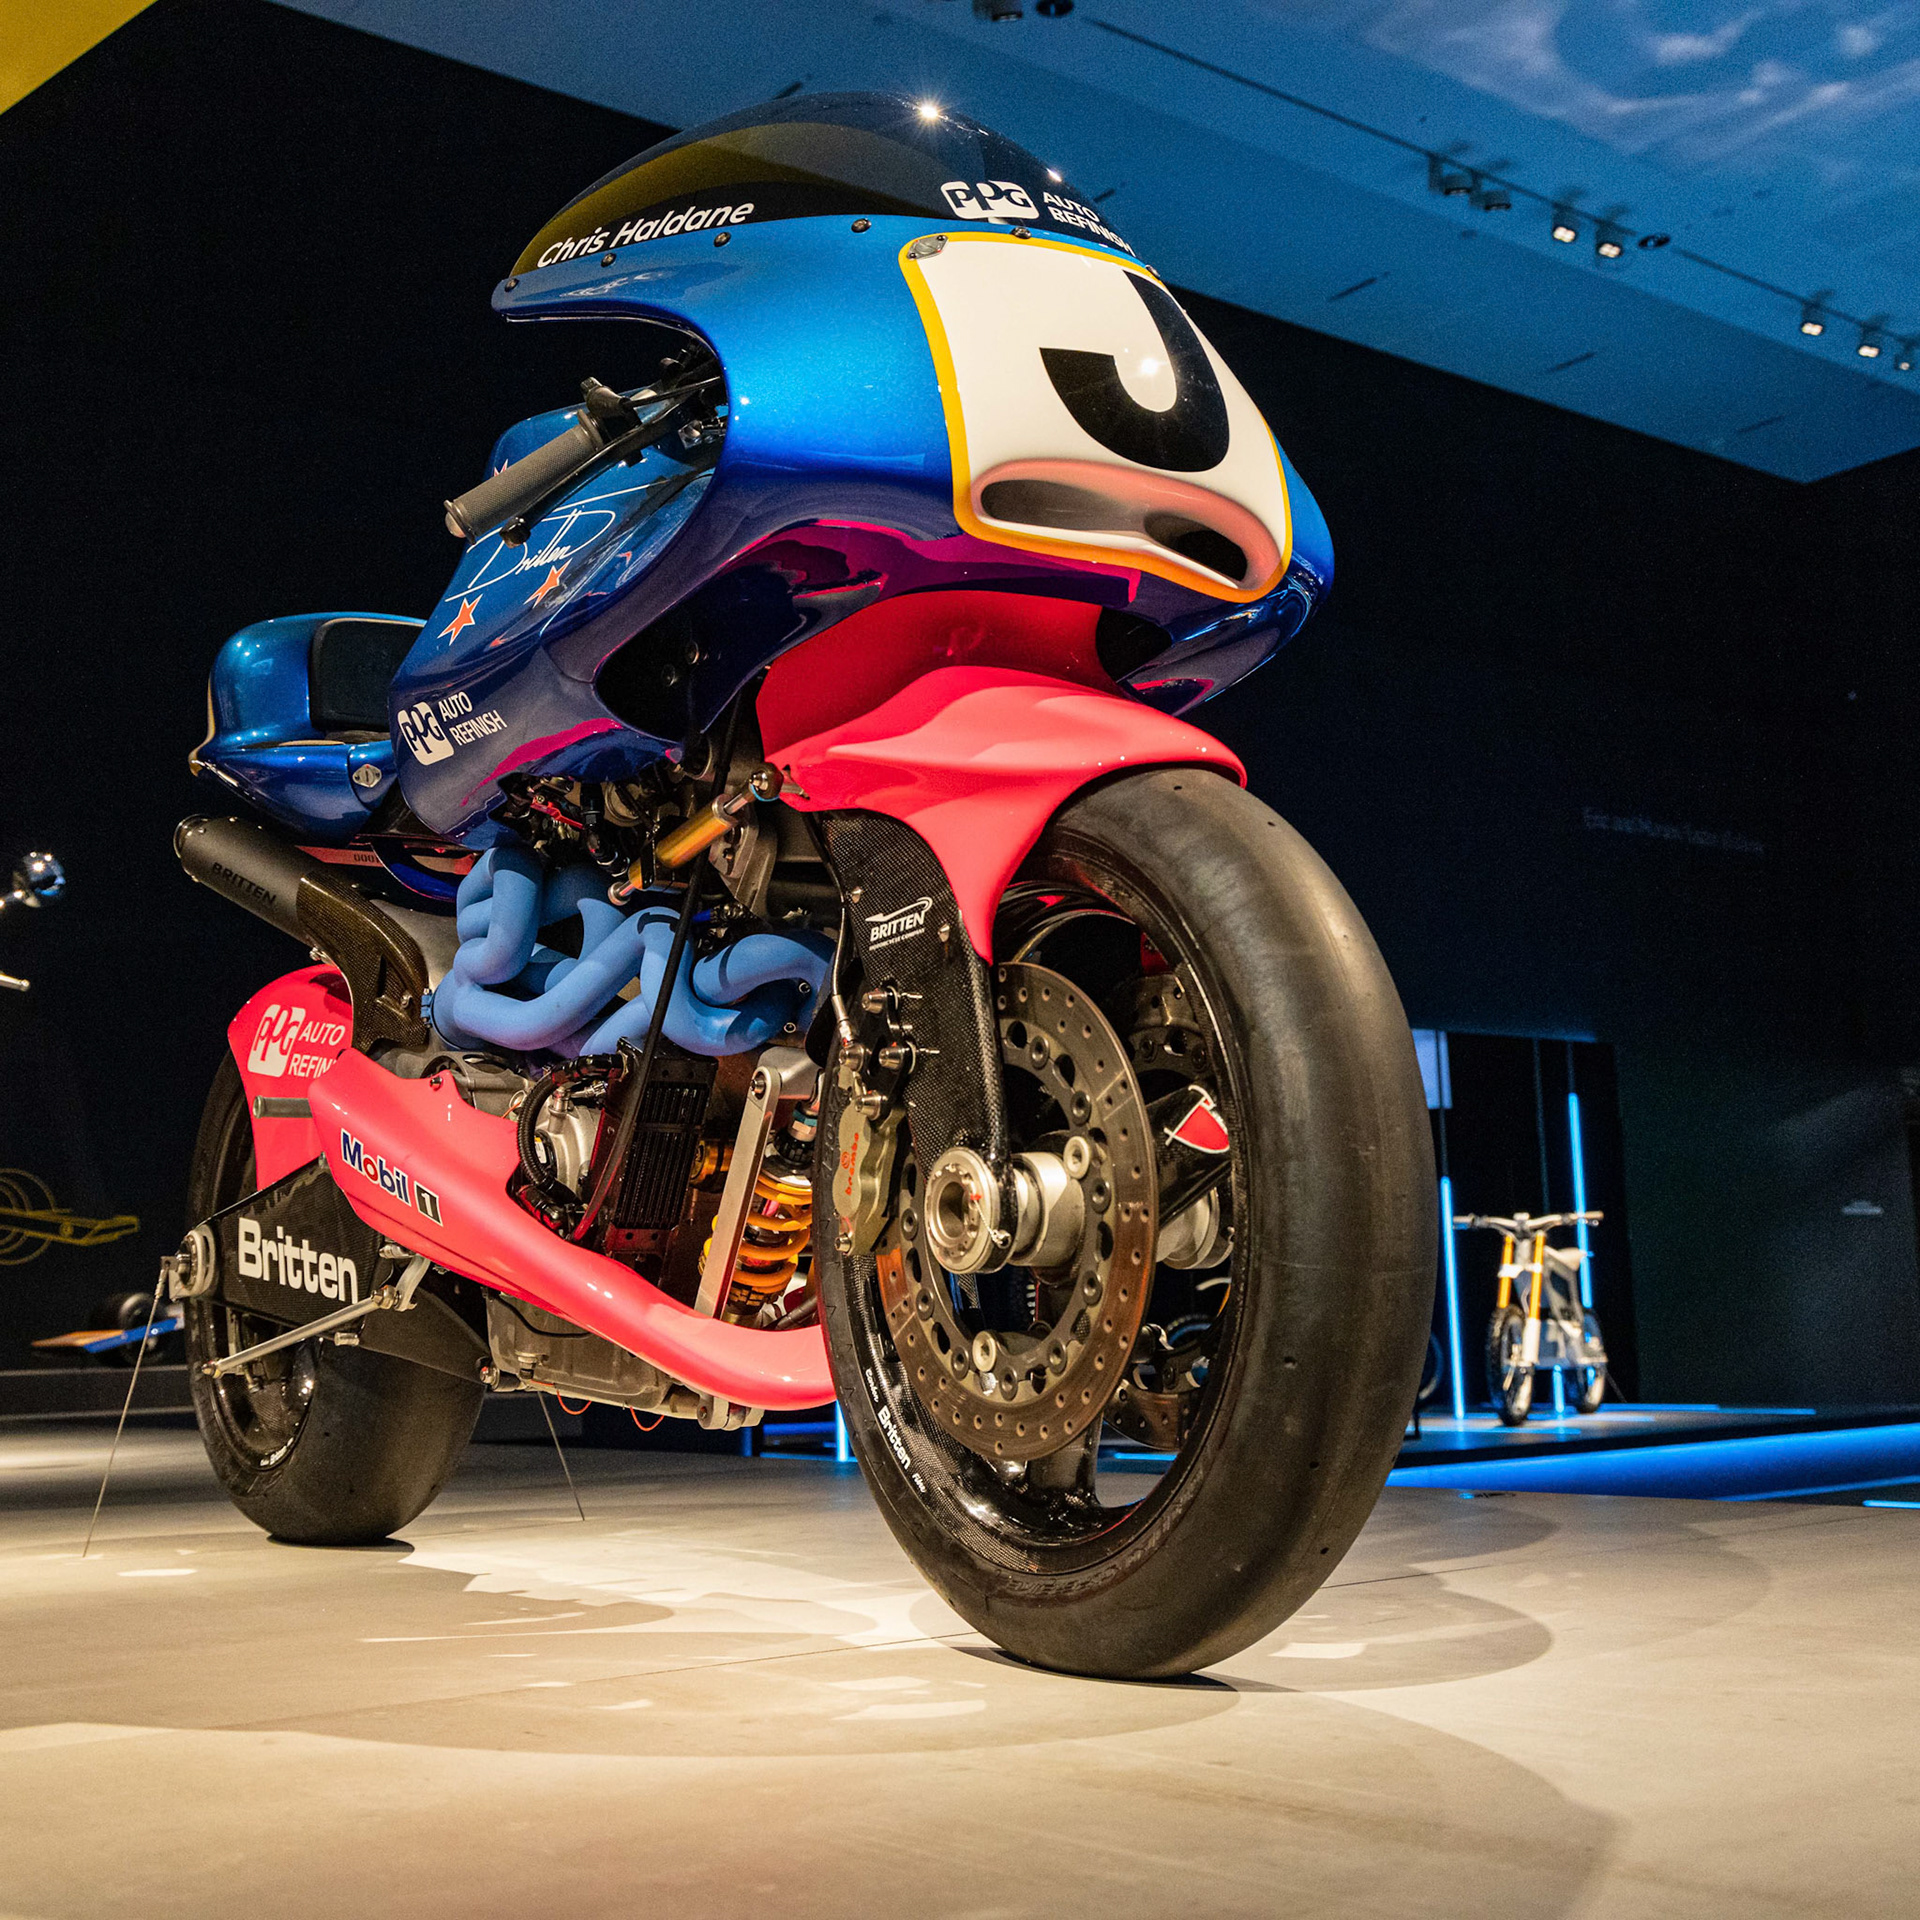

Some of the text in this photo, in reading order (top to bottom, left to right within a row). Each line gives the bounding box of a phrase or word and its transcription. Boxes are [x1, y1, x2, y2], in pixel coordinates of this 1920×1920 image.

[943, 180, 1036, 215] PPG
[1043, 192, 1099, 222] AUTO
[537, 202, 755, 268] Chris Haldane
[1048, 206, 1136, 257] REFINISH
[438, 691, 473, 722] AUTO
[449, 709, 508, 746] REFINISH
[399, 703, 449, 759] PPG
[213, 862, 277, 905] BRITTEN
[870, 911, 925, 942] BRITTEN
[250, 1005, 303, 1068] PPG
[298, 1021, 346, 1046] AUTO
[288, 1053, 337, 1079] REFIN
[341, 1128, 412, 1207] Mobil
[845, 1132, 859, 1196] brembo
[238, 1217, 359, 1305] Britten
[877, 1405, 911, 1470] Britten
